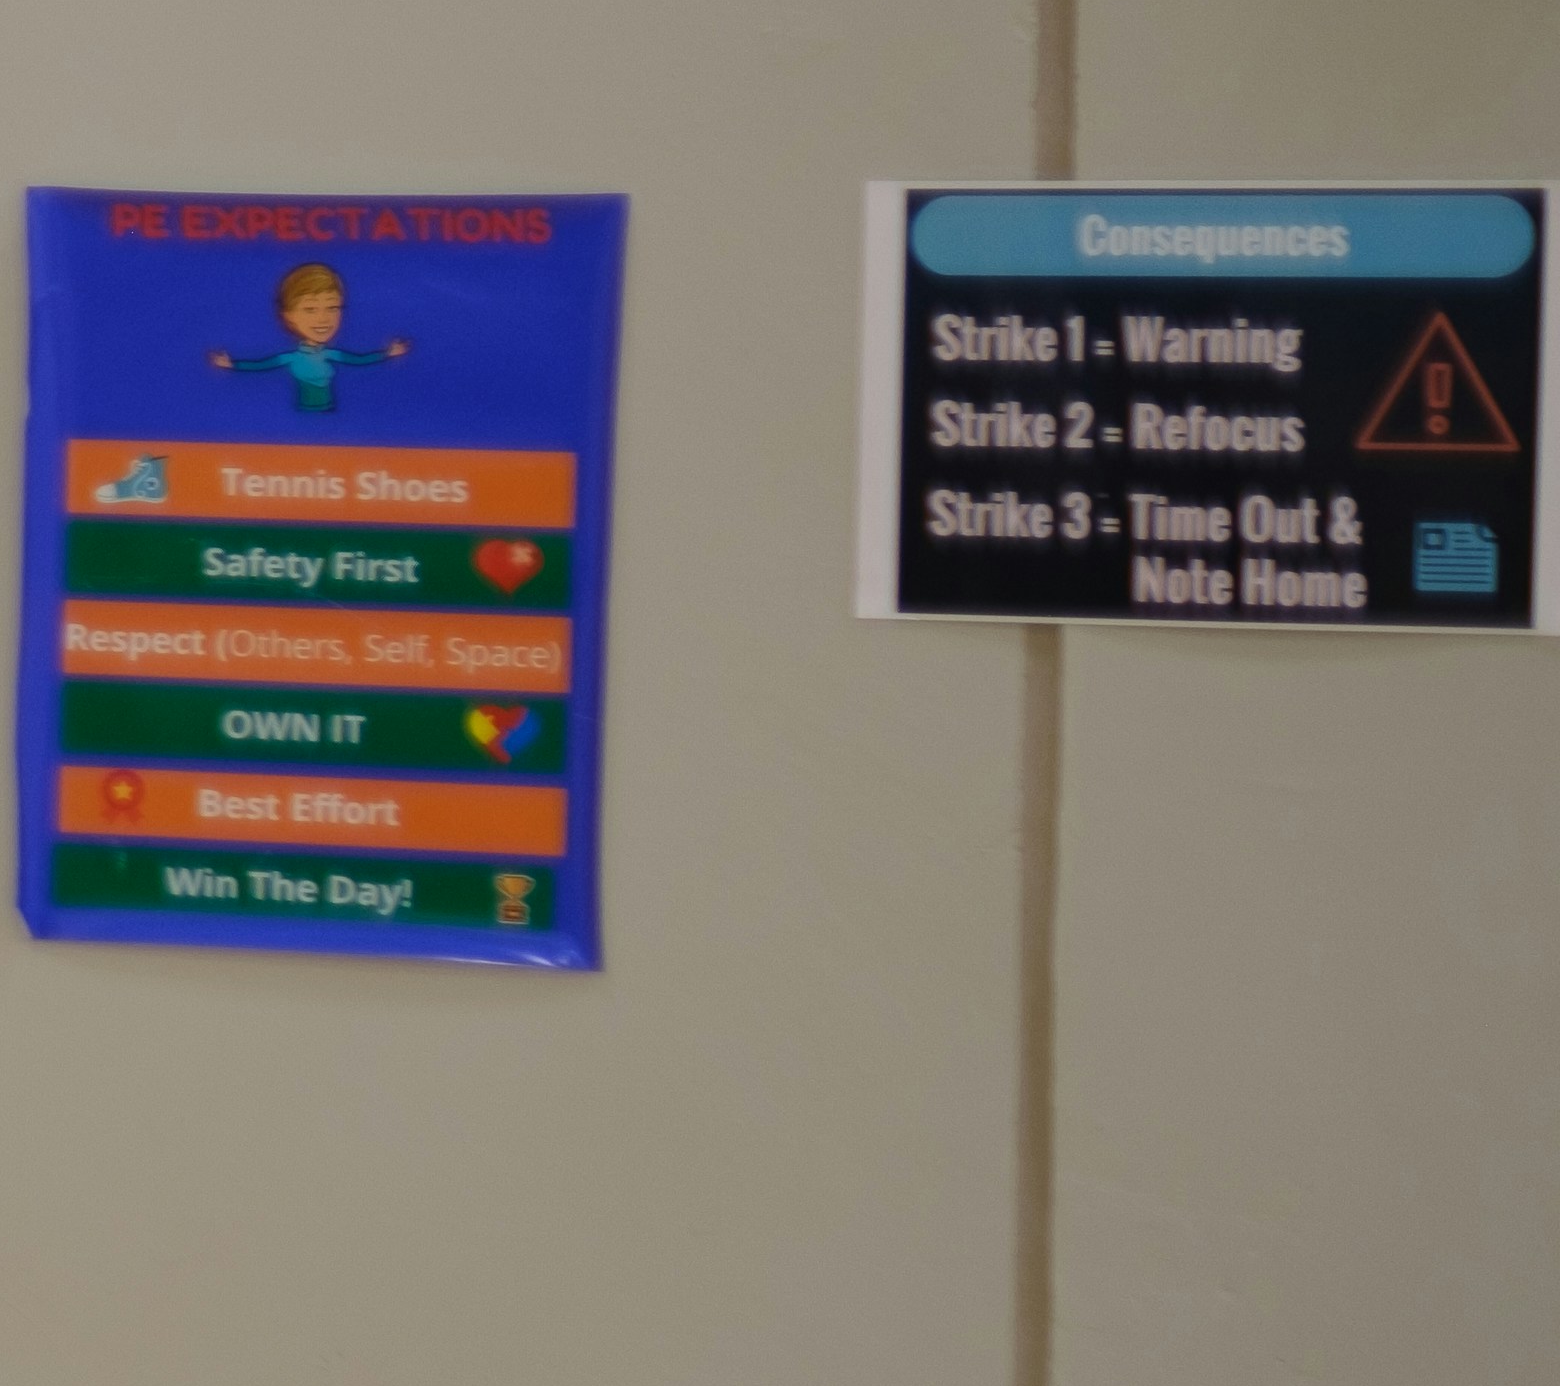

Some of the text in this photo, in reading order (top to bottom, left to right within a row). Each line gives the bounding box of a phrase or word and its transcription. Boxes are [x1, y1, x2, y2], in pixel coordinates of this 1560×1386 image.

[110, 205, 553, 244] PE EXPECTATIONS
[1077, 213, 1351, 263] Consequences
[931, 314, 1058, 362] Strike
[1065, 316, 1086, 362] 1
[1122, 315, 1304, 373] Warning
[930, 401, 1058, 450] Strike
[1063, 402, 1095, 450] 2
[1131, 403, 1306, 453] Refocus
[221, 467, 469, 504] Tennis Shoes
[927, 489, 1054, 540] Strike
[1059, 491, 1091, 541] 3
[1131, 494, 1232, 543] Time
[1239, 494, 1320, 545] Out
[1329, 496, 1364, 545] &
[203, 547, 419, 586] Safety First
[1133, 557, 1367, 608] Note Home
[67, 624, 562, 677] Respect (Others, Self, Space)
[223, 710, 365, 743] OWN IT
[196, 788, 400, 828] Best Effort
[165, 867, 413, 915] Win The Day!
